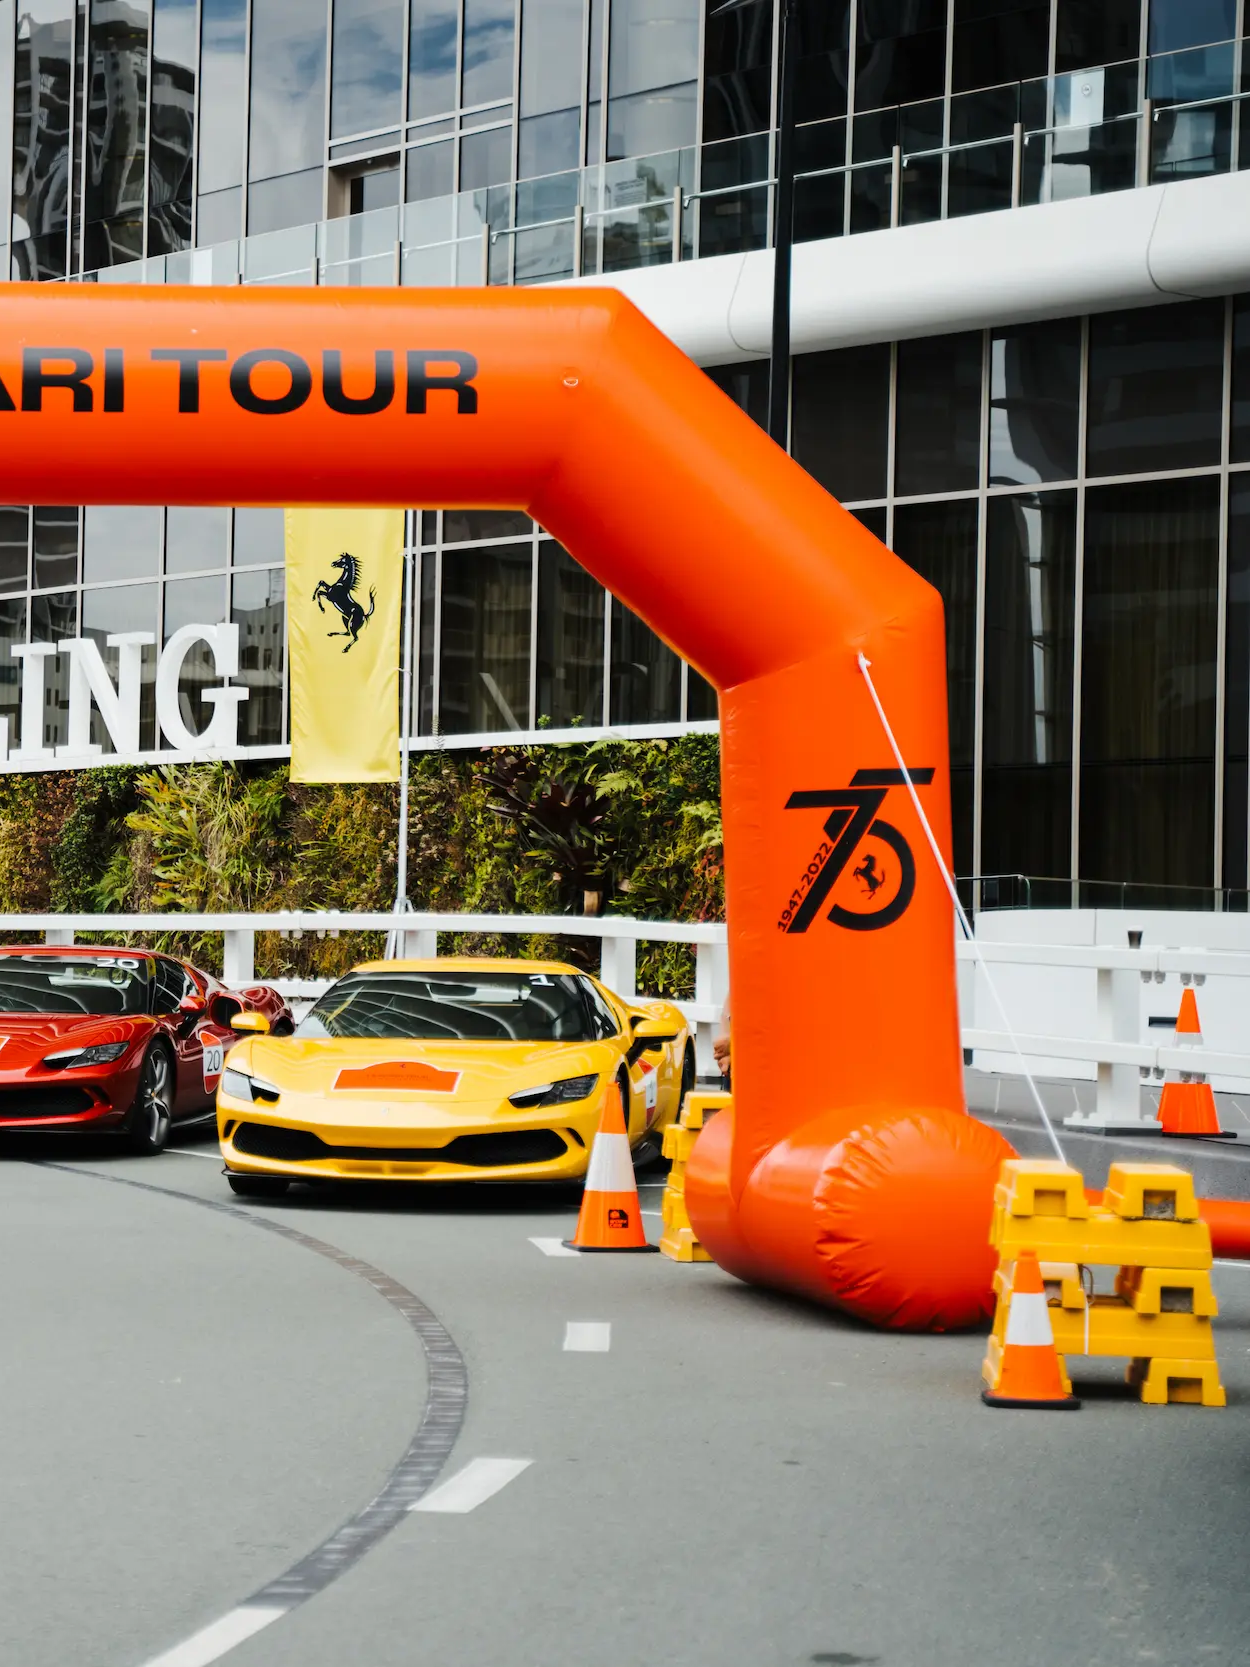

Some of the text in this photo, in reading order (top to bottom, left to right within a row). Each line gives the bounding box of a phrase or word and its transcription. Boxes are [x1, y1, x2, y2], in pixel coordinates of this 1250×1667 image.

[151, 348, 479, 415] TOUR
[784, 768, 936, 933] 75
[777, 841, 833, 933] 1947-2022
[97, 957, 140, 969] 20
[529, 974, 555, 987] 1
[206, 1049, 221, 1072] 20
